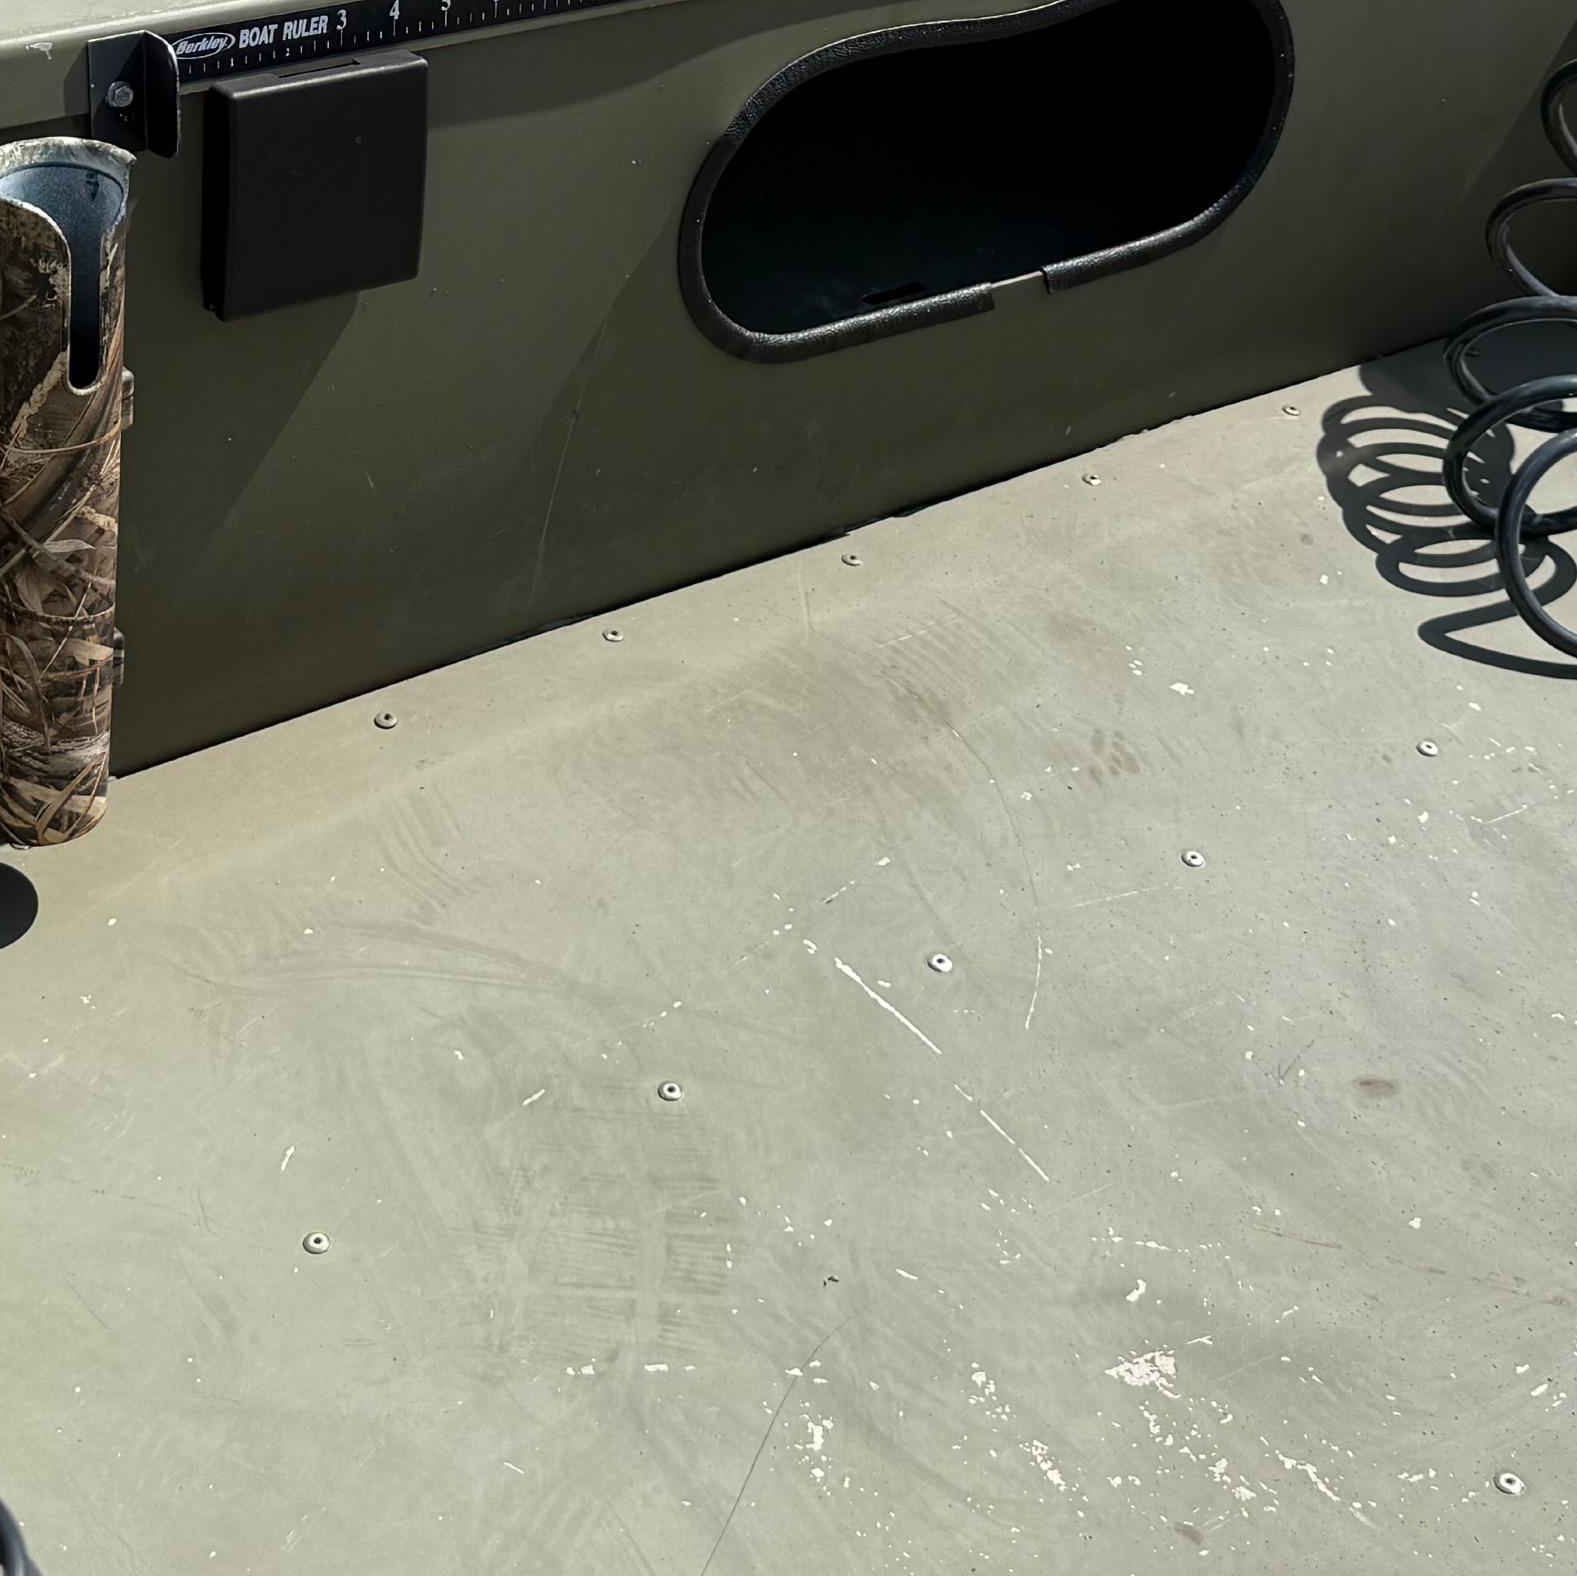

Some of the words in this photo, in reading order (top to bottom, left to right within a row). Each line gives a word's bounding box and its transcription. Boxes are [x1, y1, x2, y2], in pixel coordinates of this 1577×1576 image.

[176, 35, 229, 55] Berkley
[239, 24, 278, 49] BOAT
[282, 15, 329, 41] RULER
[336, 9, 347, 30] 3
[389, 0, 400, 20] 4
